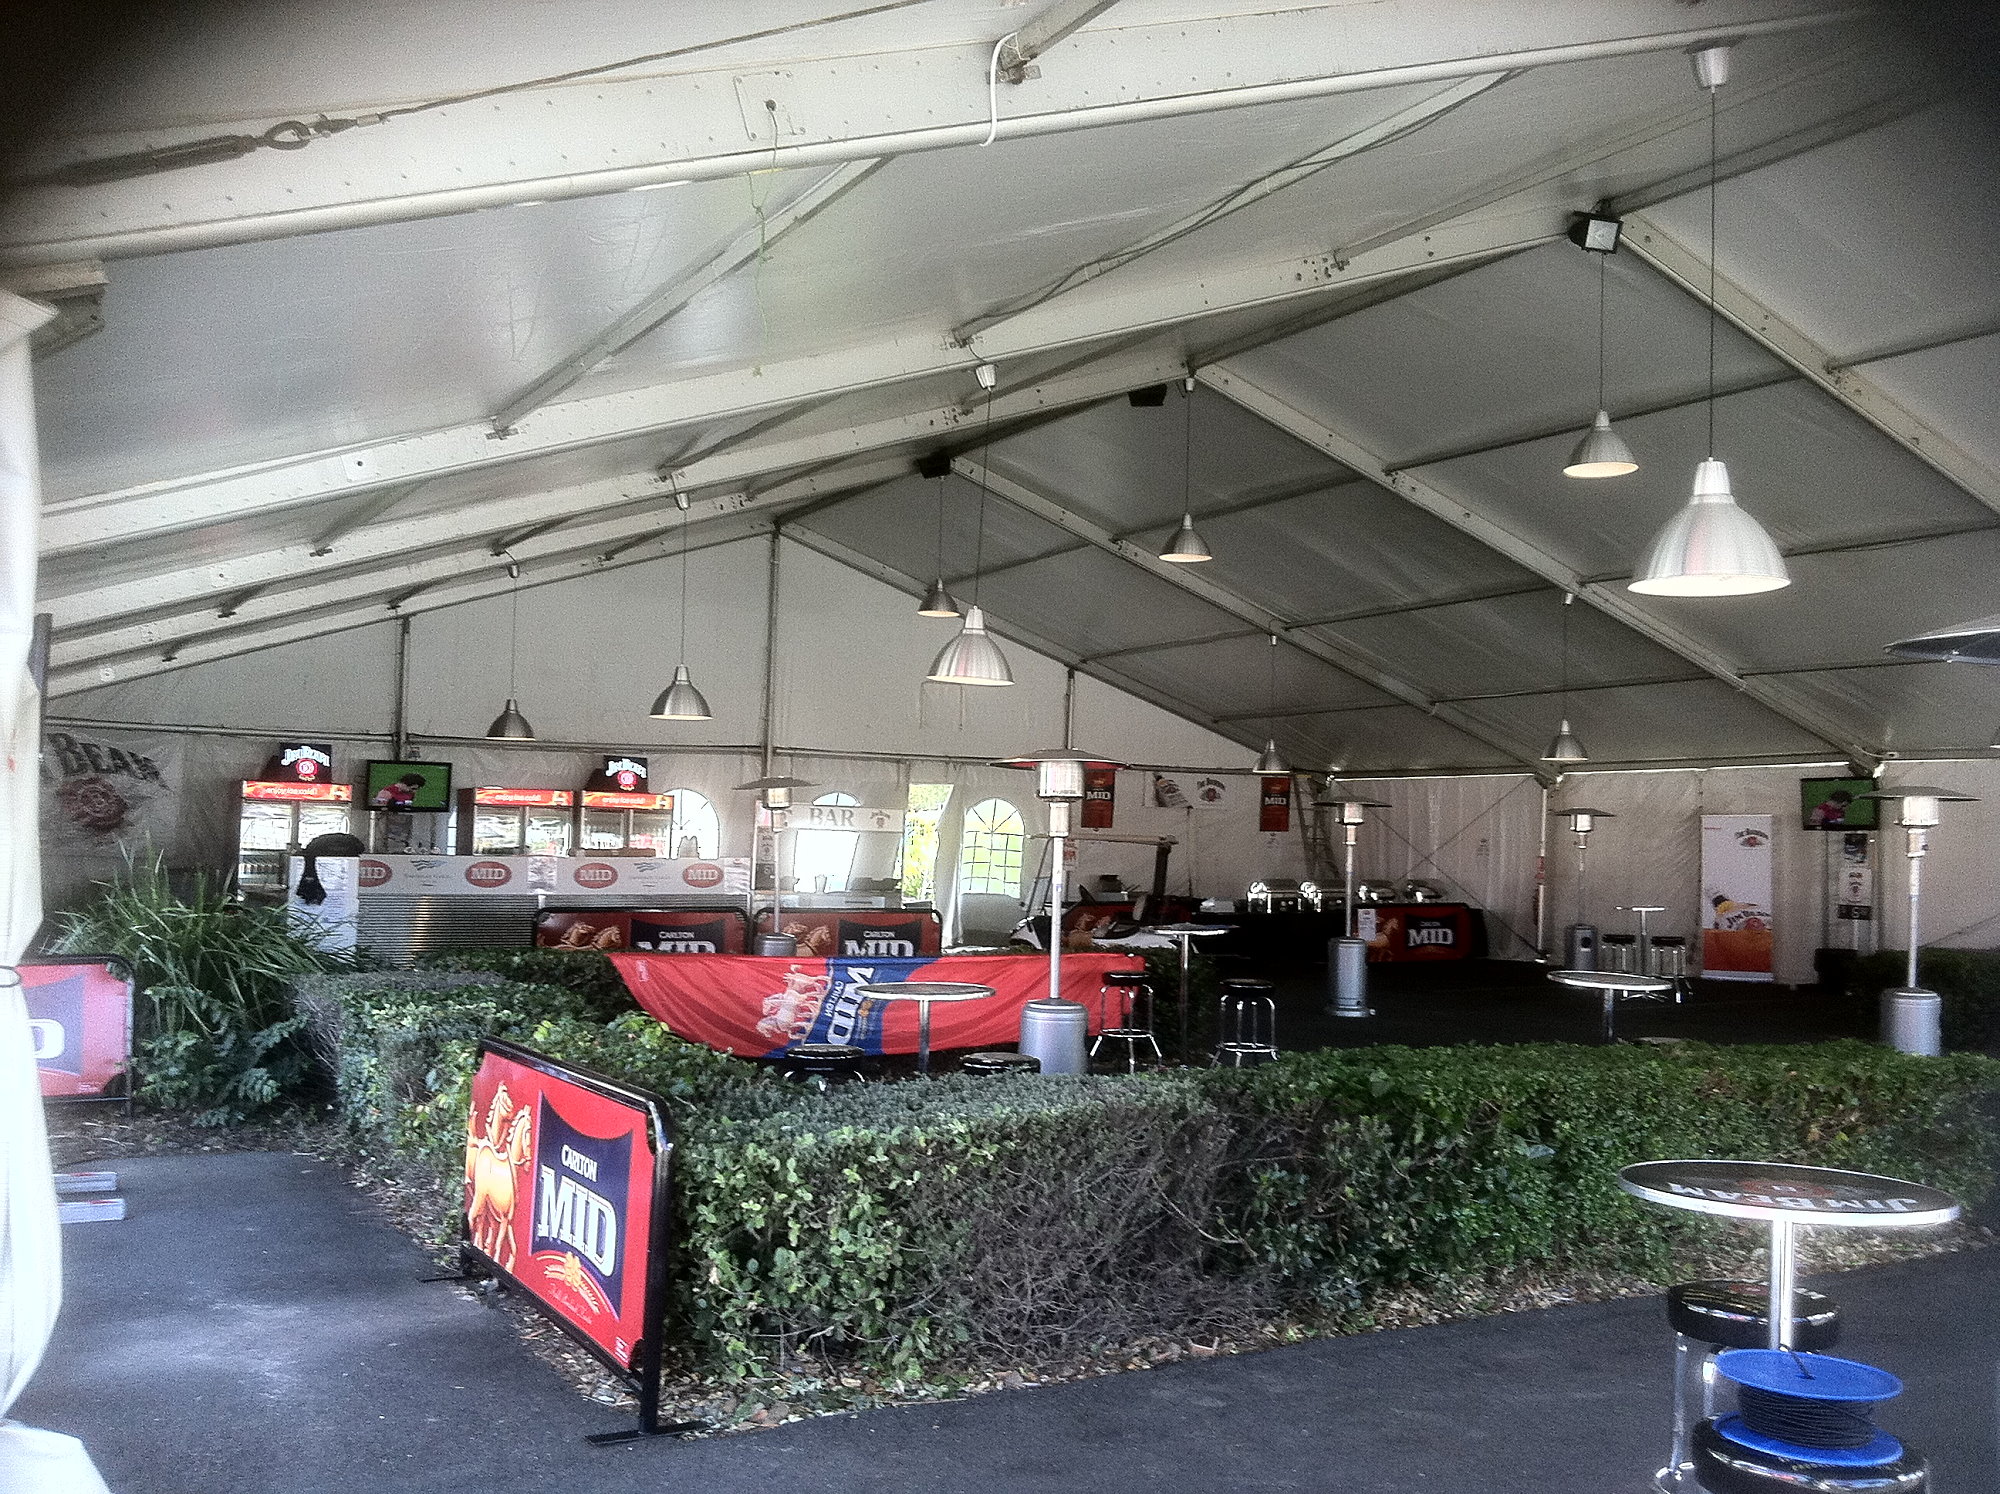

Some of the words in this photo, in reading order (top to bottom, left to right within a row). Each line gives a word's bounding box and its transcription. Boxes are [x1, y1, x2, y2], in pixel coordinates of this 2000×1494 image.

[1085, 790, 1111, 801] MID
[1264, 796, 1287, 806] MID
[809, 807, 854, 827] BAR
[471, 868, 505, 880] MID
[580, 869, 613, 881] MID
[688, 869, 719, 881] MID
[1407, 928, 1453, 946] MID
[561, 1144, 598, 1182] CARLTON
[1667, 1182, 1817, 1209] BEAM
[1828, 1198, 1917, 1211] JIM
[537, 1164, 617, 1277] MID
